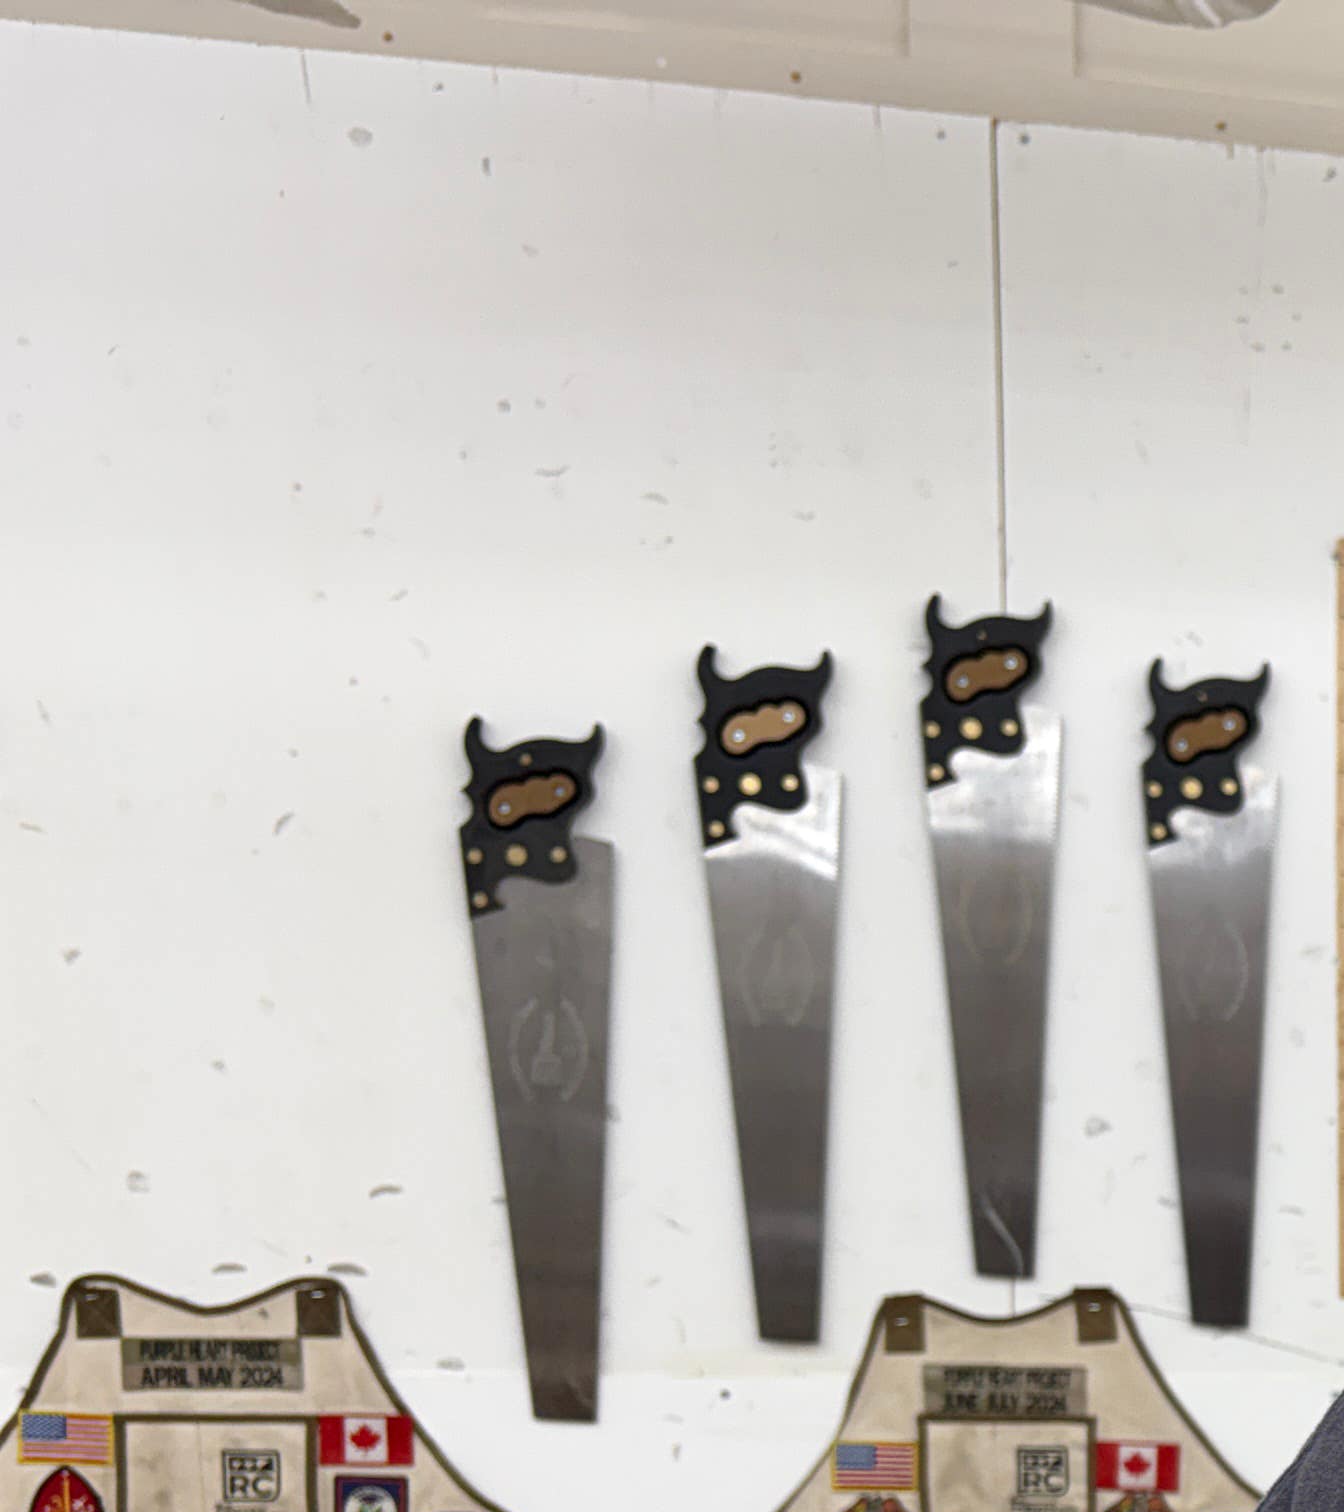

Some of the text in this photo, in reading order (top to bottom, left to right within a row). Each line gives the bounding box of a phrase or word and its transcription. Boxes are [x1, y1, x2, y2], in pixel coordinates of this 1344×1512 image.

[141, 1366, 284, 1388] APRIL MAY 2024
[229, 1474, 273, 1498] RC
[1023, 1471, 1065, 1494] RC
